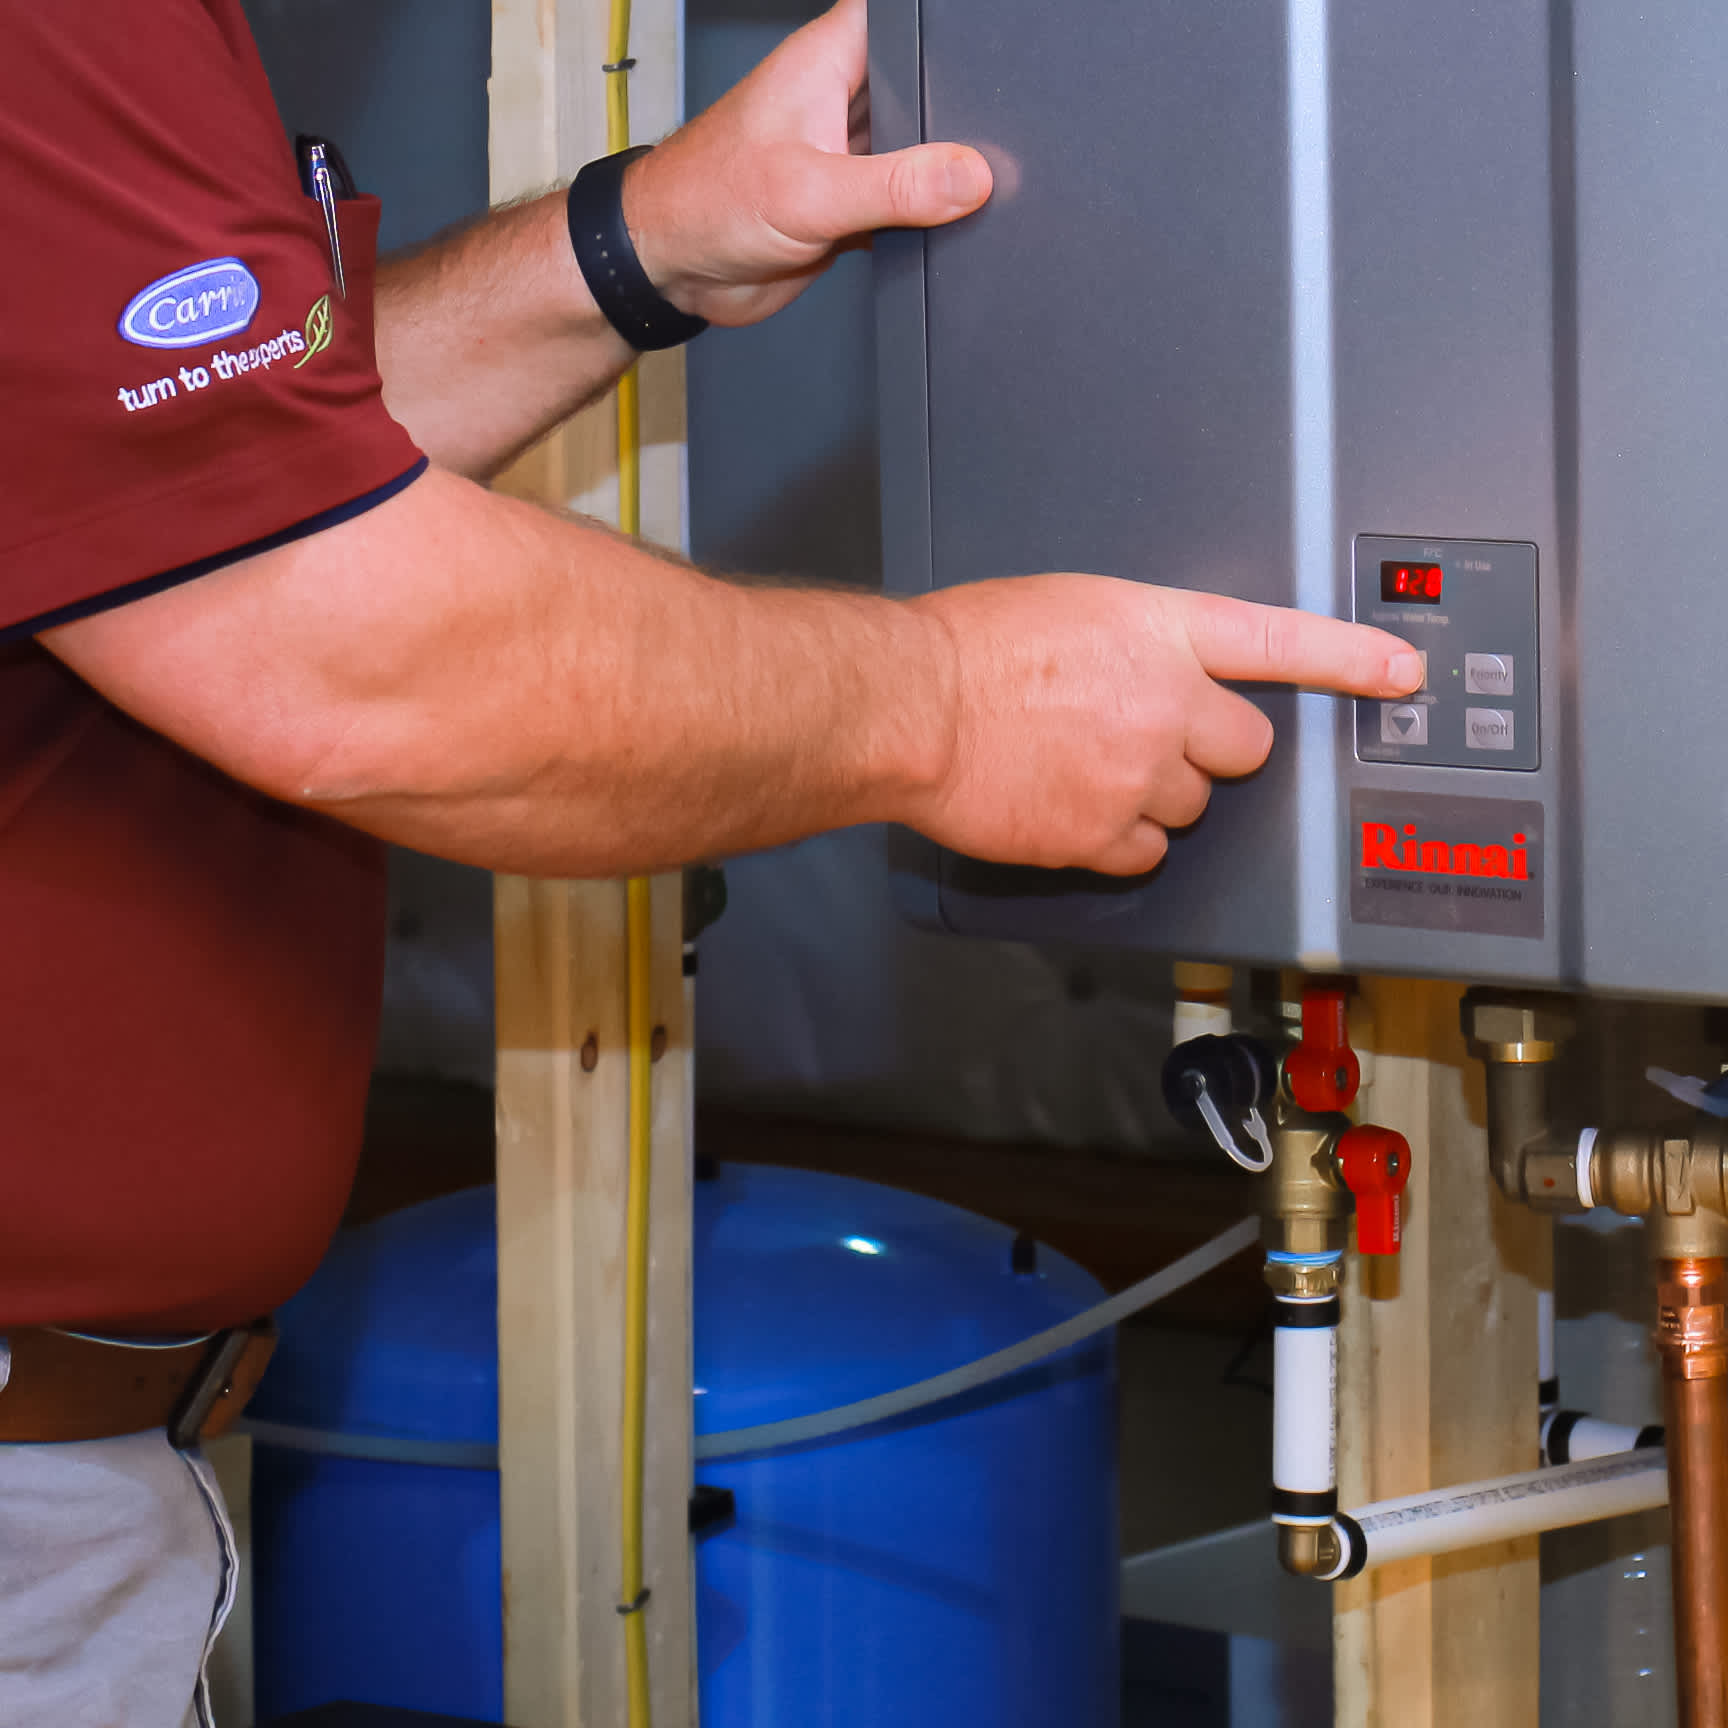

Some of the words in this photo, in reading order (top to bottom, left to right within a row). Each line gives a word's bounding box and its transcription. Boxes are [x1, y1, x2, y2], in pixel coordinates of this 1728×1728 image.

[118, 374, 176, 412] turn
[178, 365, 210, 393] to
[211, 352, 249, 380] the
[1469, 665, 1509, 685] Priority
[1471, 722, 1510, 738] On/Off
[1360, 820, 1530, 882] Rinnai
[1365, 876, 1423, 895] EXPERIENCE
[1455, 884, 1522, 903] INNOVATION
